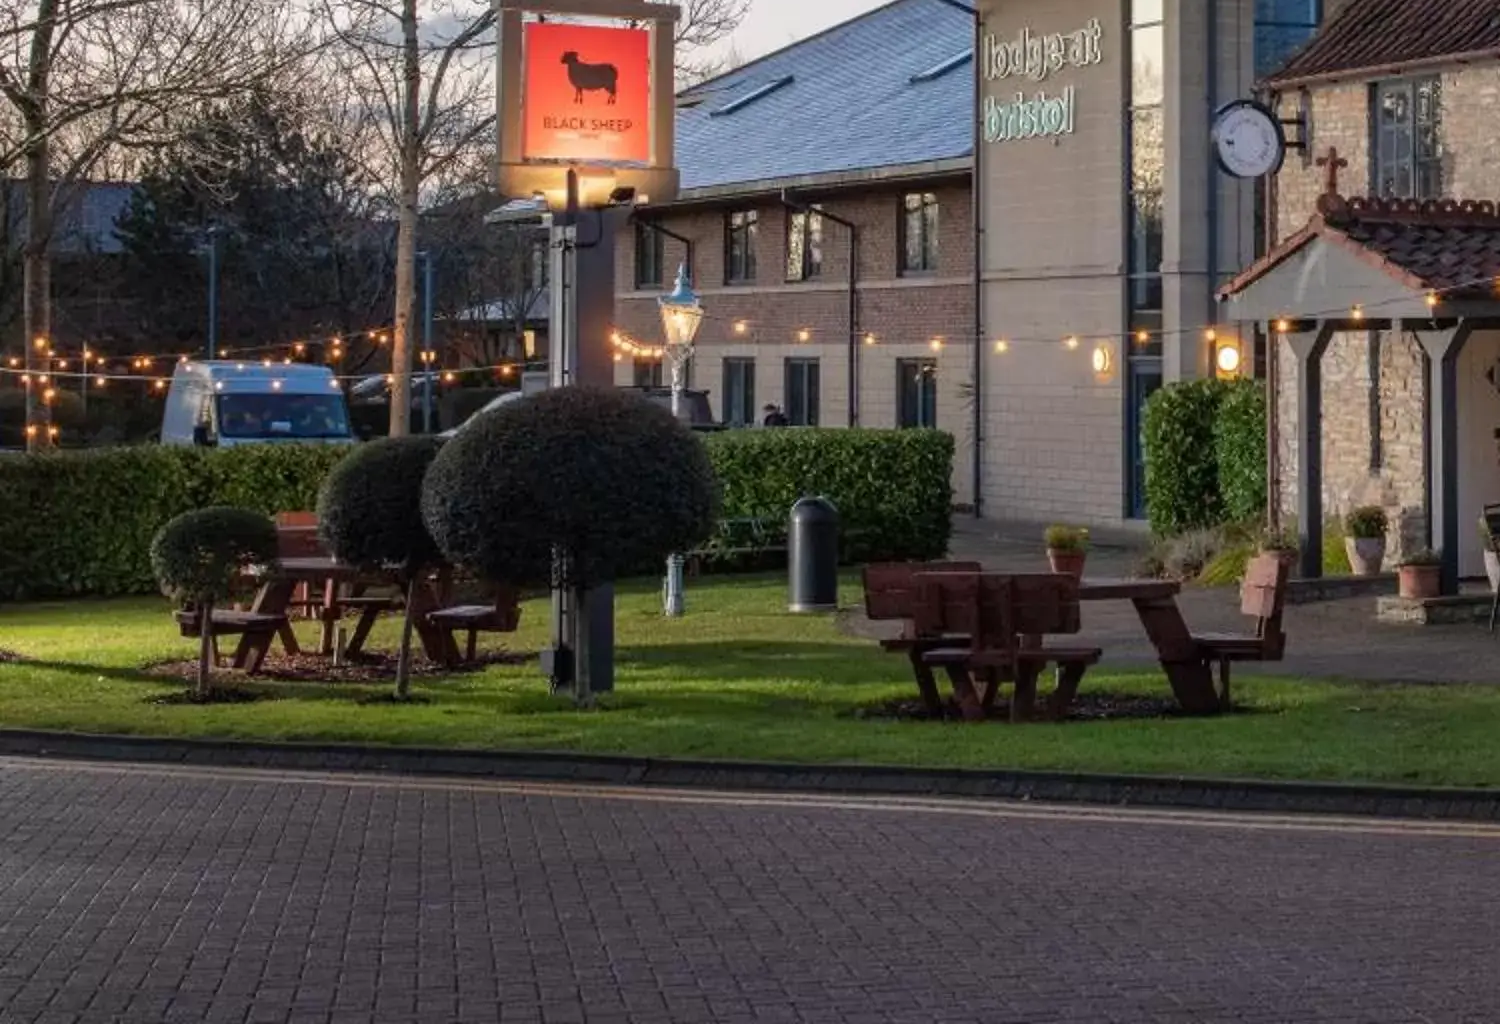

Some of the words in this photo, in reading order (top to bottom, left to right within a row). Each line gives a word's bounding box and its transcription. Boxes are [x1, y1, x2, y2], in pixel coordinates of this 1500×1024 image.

[984, 27, 1064, 81] lodge
[543, 115, 585, 130] BLACK
[591, 117, 633, 133] SHEEP
[984, 84, 1076, 143] bristol
